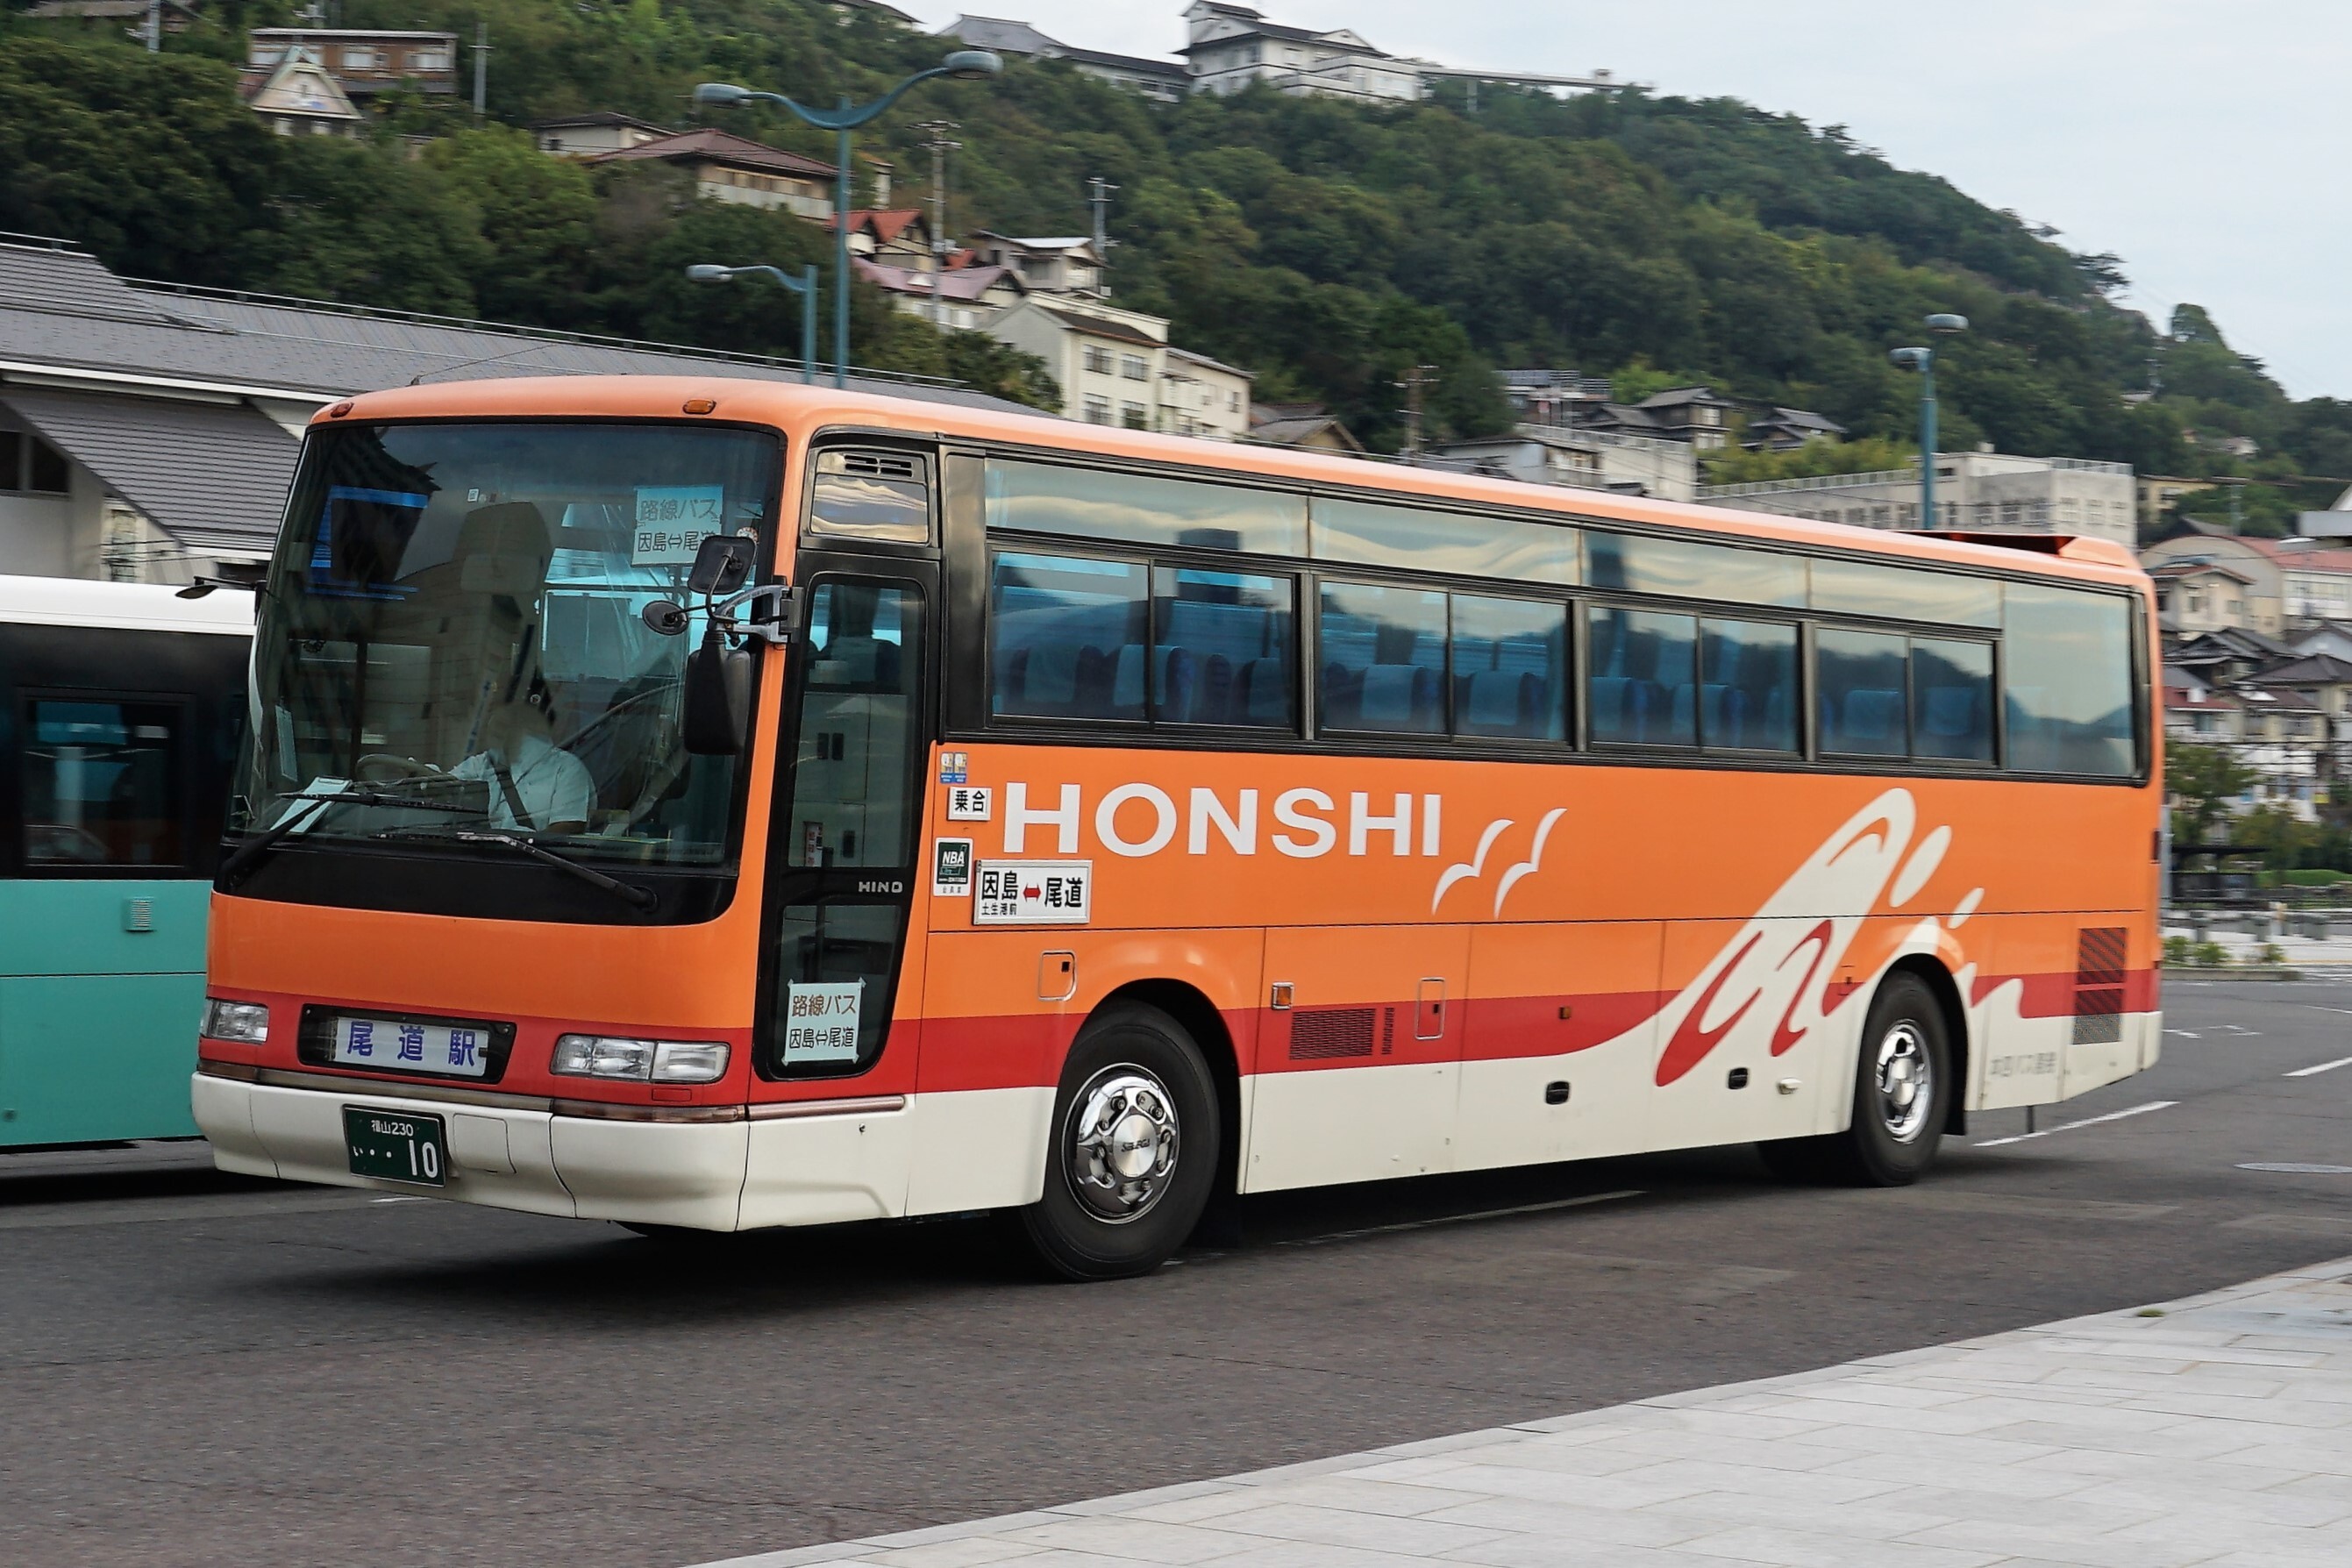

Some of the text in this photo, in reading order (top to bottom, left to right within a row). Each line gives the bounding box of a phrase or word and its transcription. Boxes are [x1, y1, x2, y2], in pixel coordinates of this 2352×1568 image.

[640, 498, 718, 522] 路線バス
[638, 532, 666, 552] 因島
[954, 789, 986, 813] 乗合
[1003, 781, 1442, 859] HONSHI
[942, 851, 966, 865] NBA
[858, 880, 903, 893] HINO
[981, 871, 1084, 909] 因島 尾道
[791, 994, 857, 1017] 路線バス
[346, 1021, 476, 1067] 尾道駅
[788, 1026, 855, 1049] 因島 尾道
